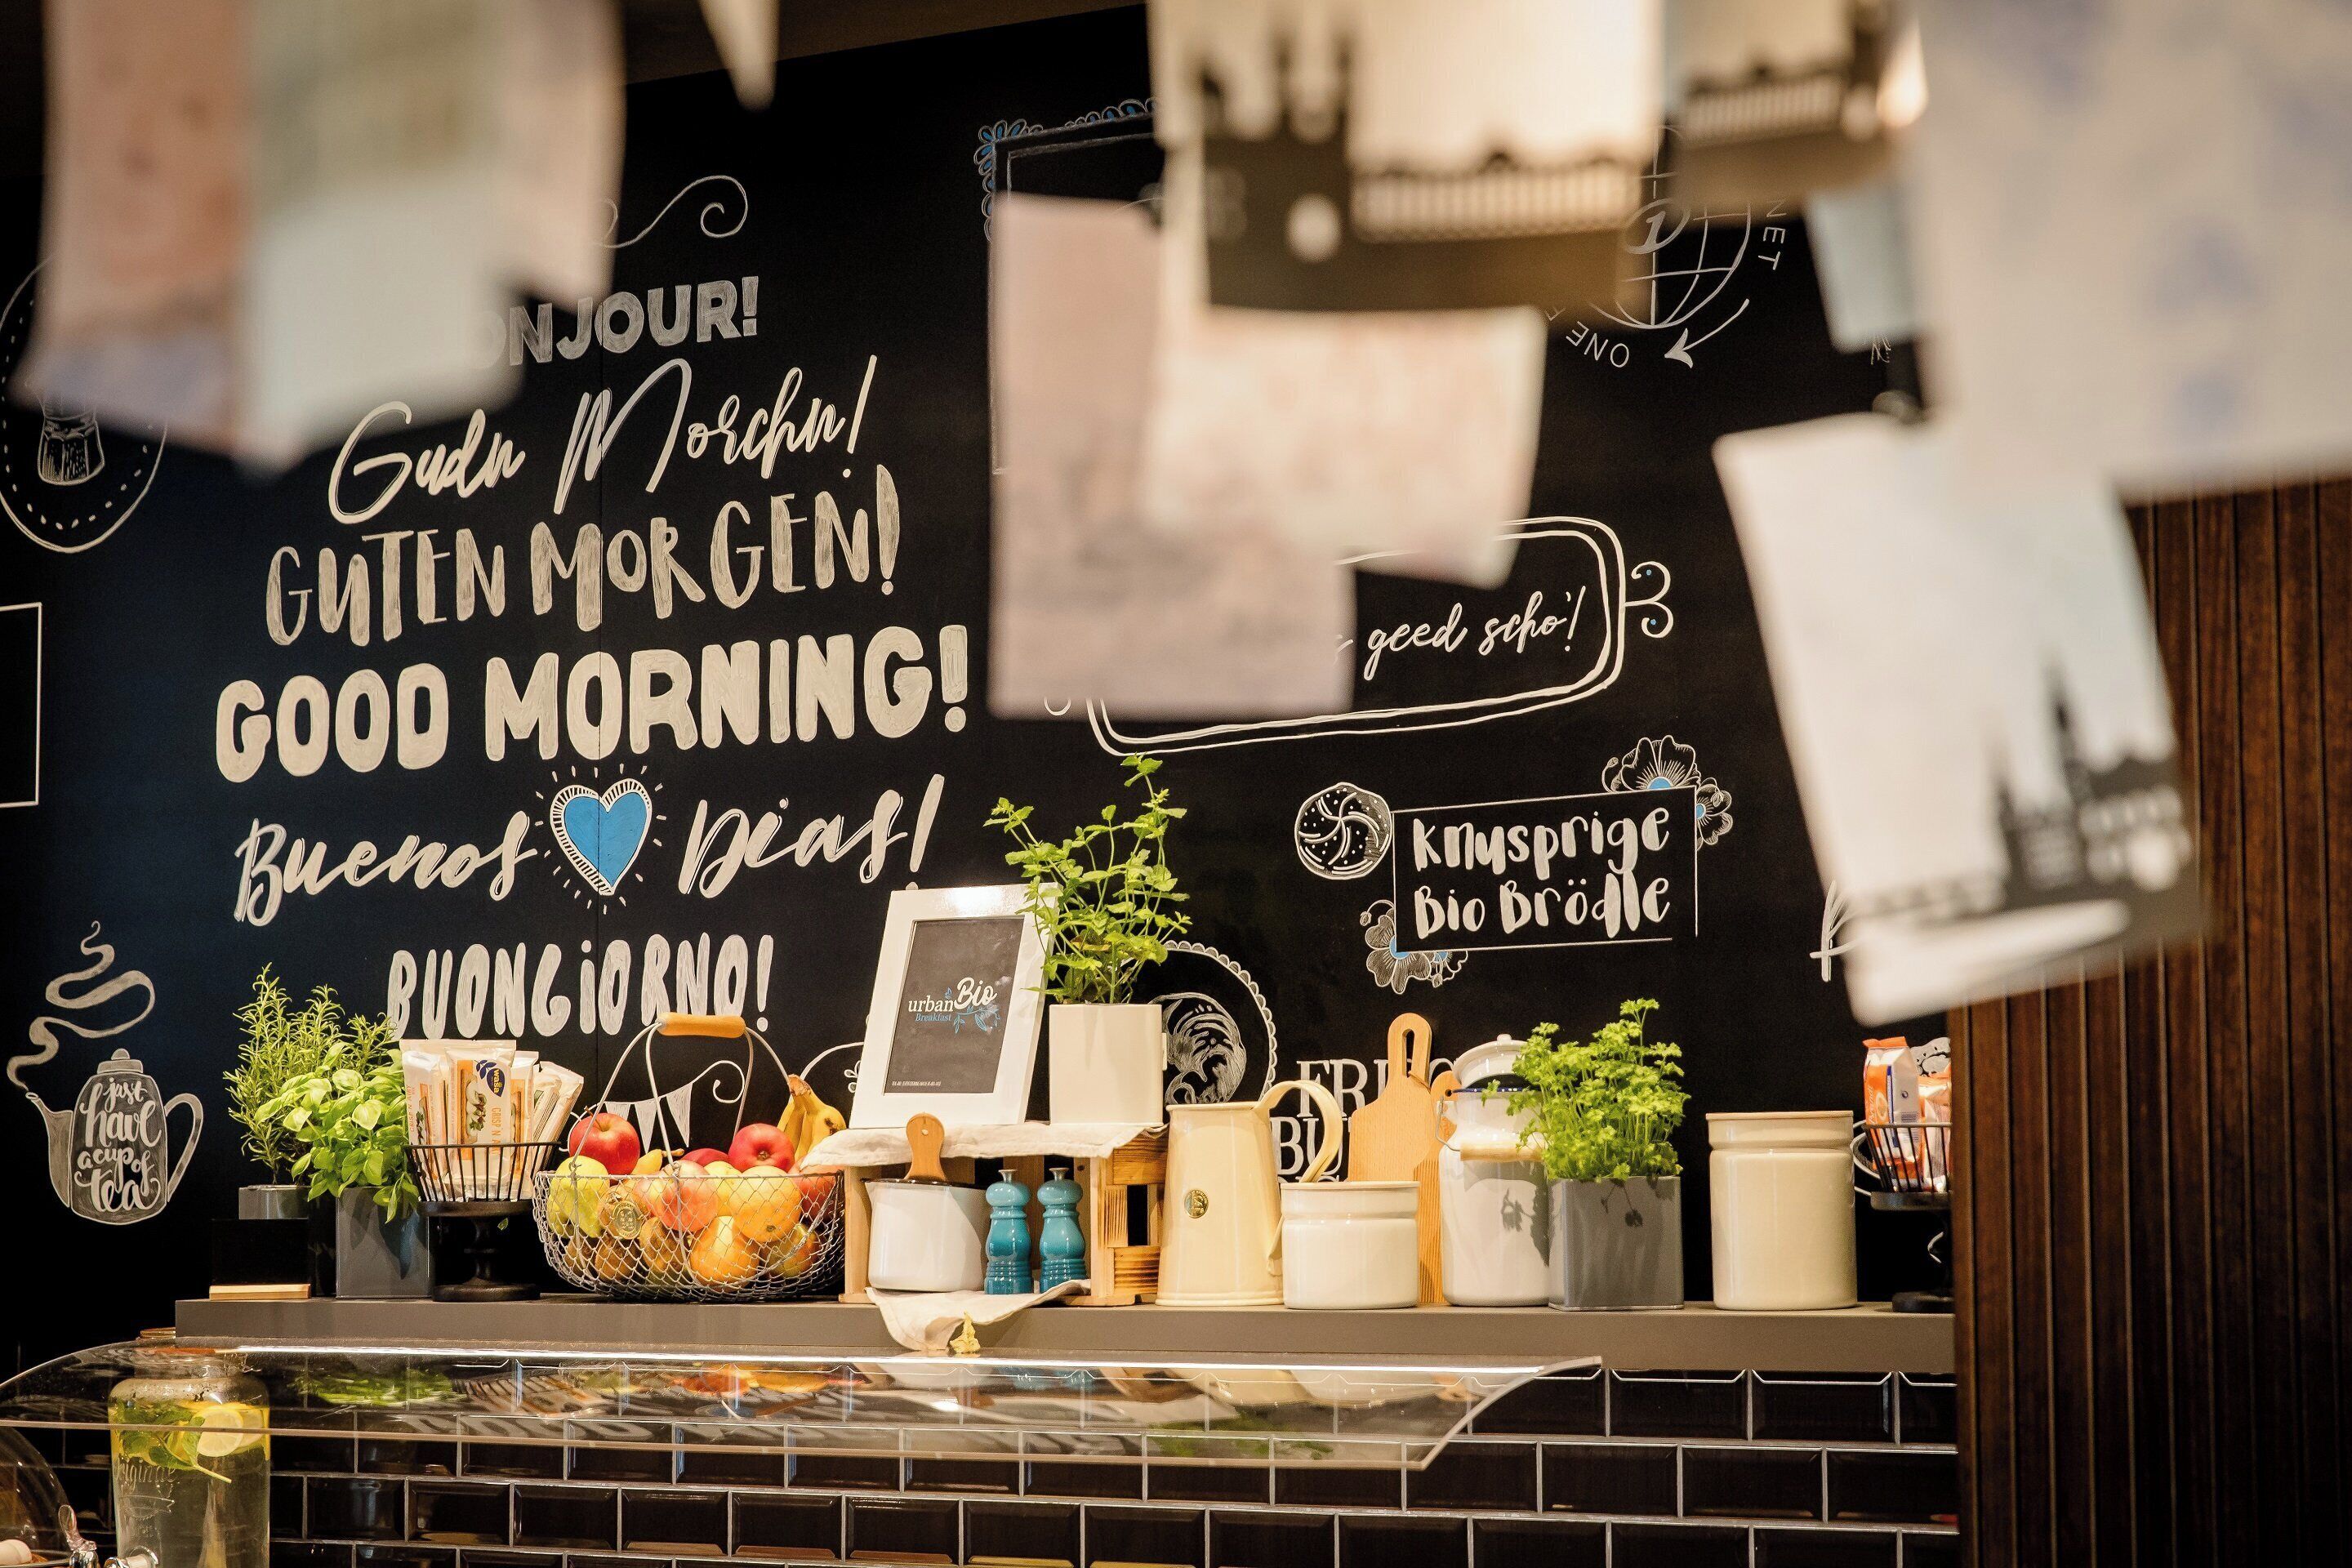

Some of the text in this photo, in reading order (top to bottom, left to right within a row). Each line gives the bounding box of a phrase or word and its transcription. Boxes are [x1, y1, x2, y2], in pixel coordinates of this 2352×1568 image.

[266, 465, 901, 647] GUTEN MORGEN!
[1363, 603, 1468, 681] geed
[216, 624, 969, 783] GOOD MORNING!
[234, 773, 946, 928] Buenos Dias!
[1414, 868, 1671, 939] Bio Brödle
[907, 977, 998, 1013] urban Bio
[915, 1013, 951, 1022] Breakfast
[79, 1082, 162, 1147] have
[103, 1077, 147, 1113] just
[74, 1168, 162, 1213] tea
[77, 1147, 155, 1197] a cup of
